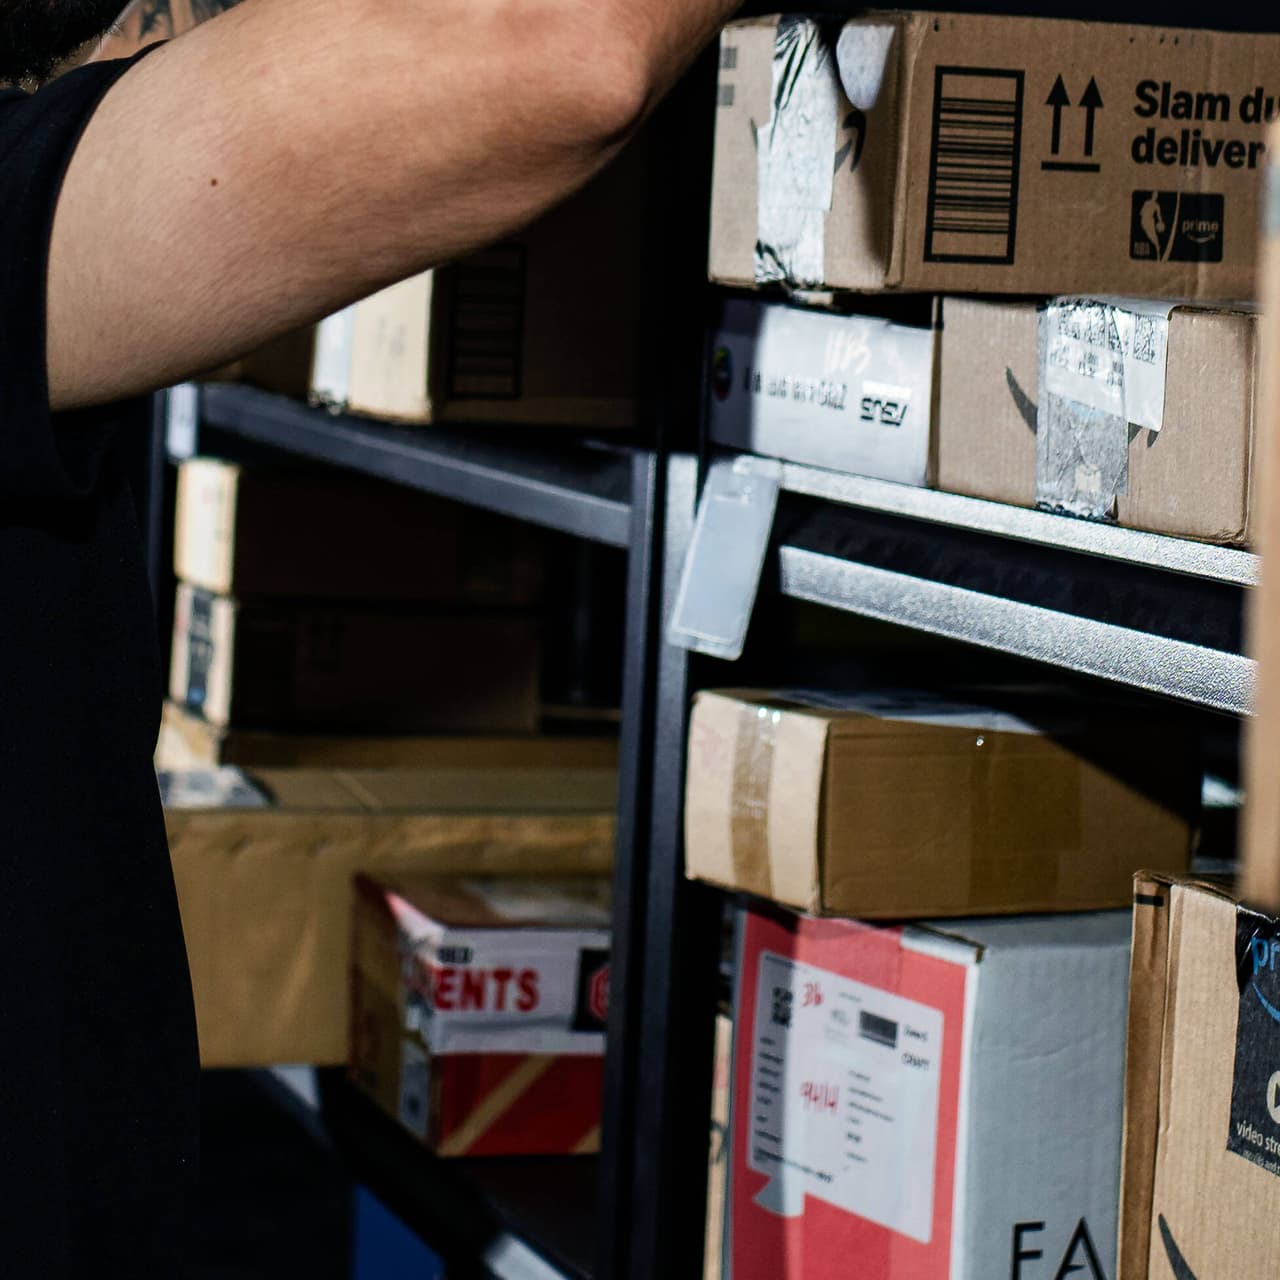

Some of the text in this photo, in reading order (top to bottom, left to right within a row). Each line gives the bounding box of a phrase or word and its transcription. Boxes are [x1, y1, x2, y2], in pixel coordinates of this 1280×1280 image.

[1134, 79, 1230, 121] Slam
[1182, 218, 1219, 233] prime
[1236, 1120, 1263, 1147] video
